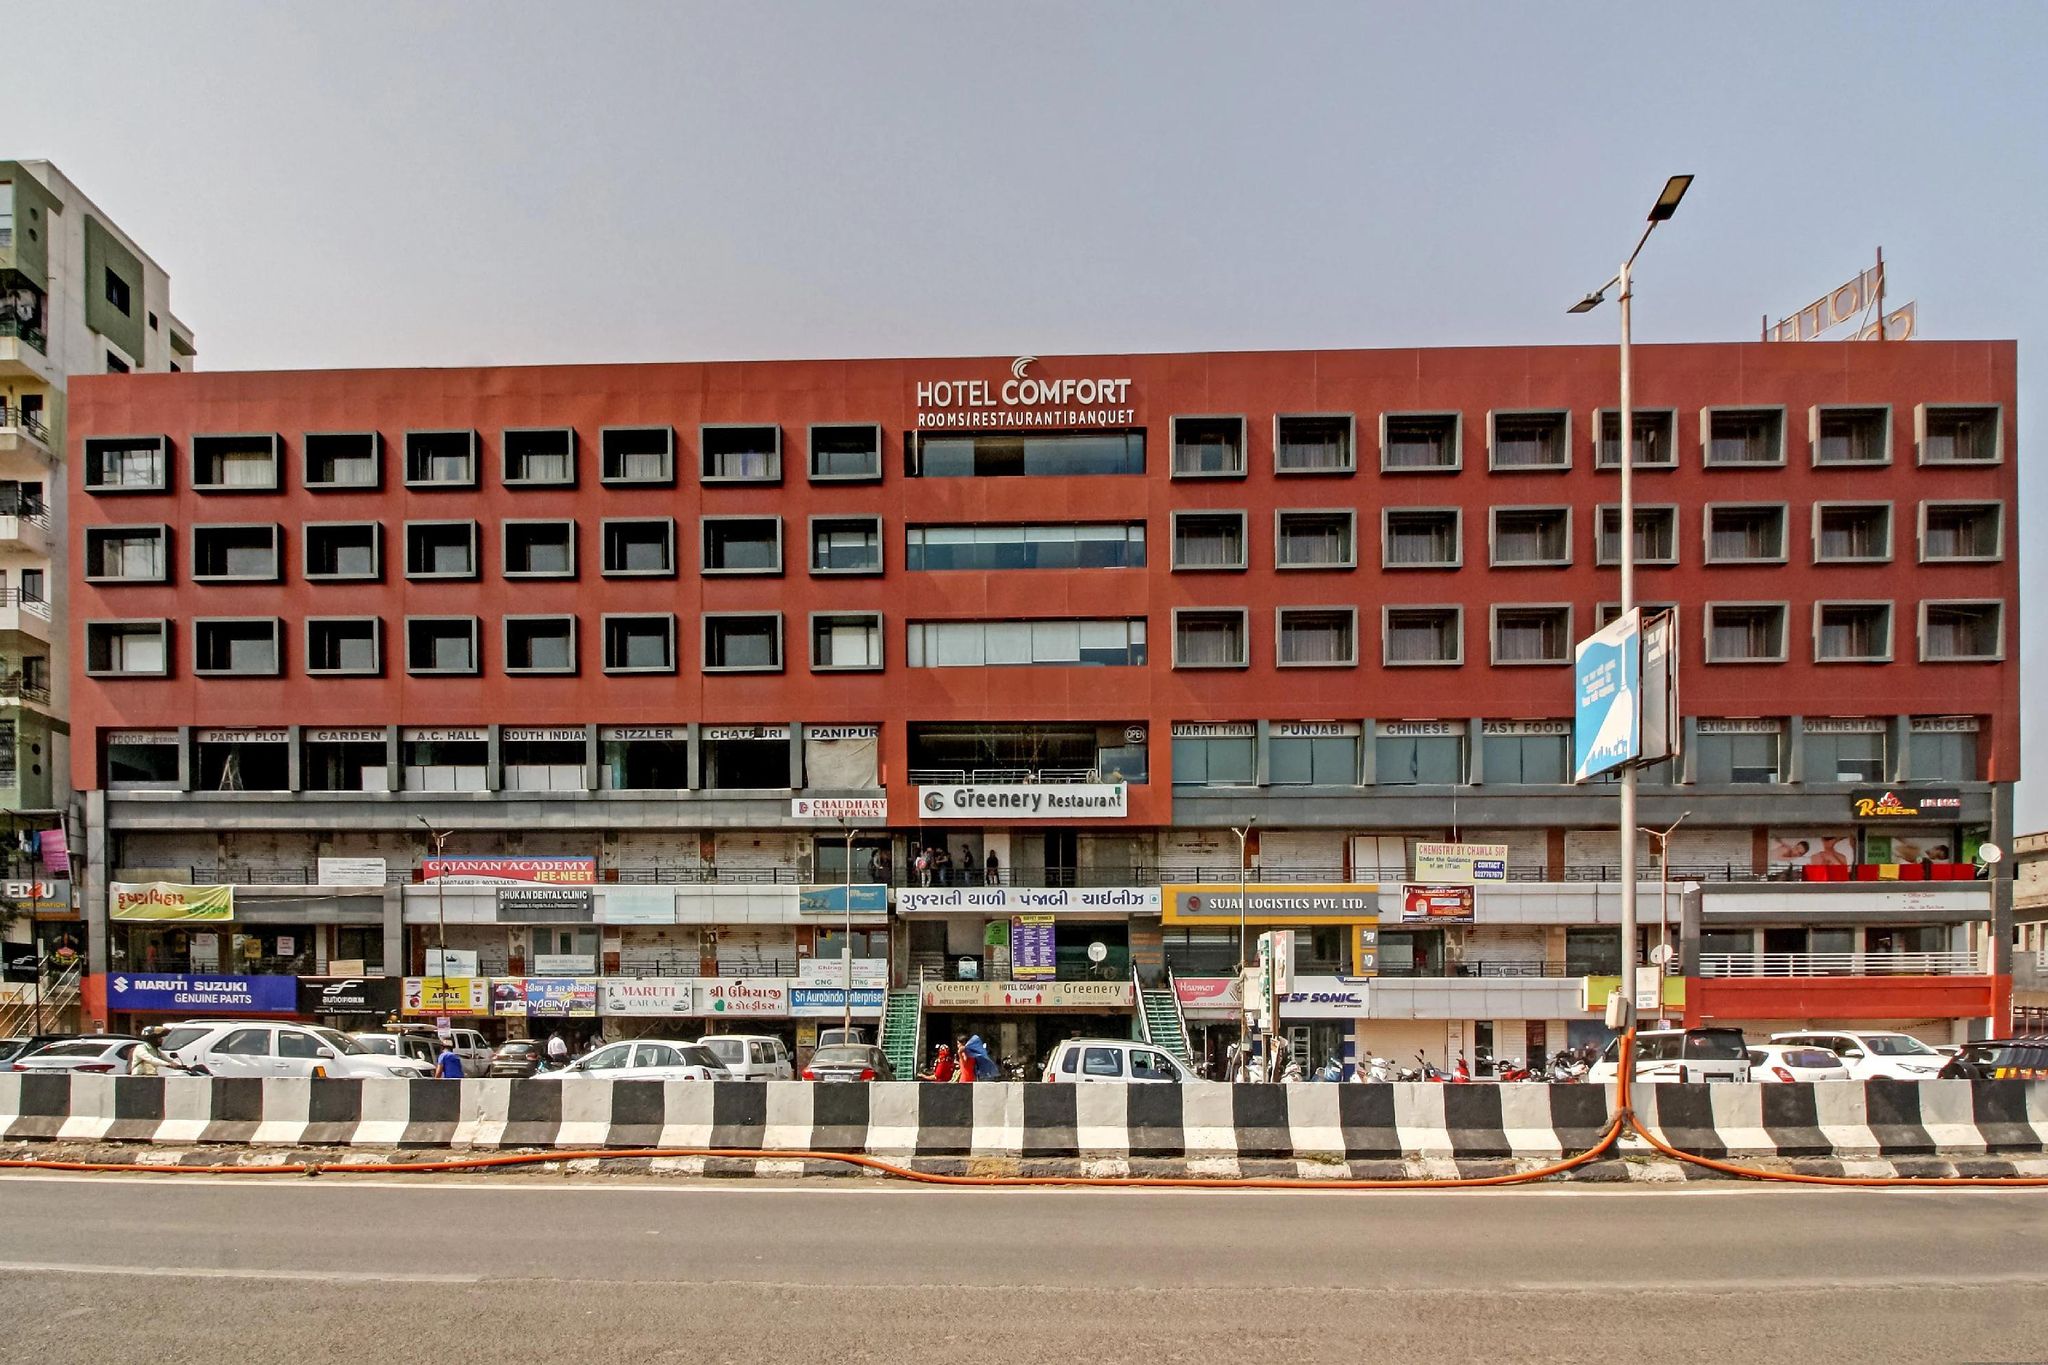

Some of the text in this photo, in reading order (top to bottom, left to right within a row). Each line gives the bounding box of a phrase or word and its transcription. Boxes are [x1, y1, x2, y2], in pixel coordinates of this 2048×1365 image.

[917, 378, 1131, 407] HOTEL COMFORT
[1280, 725, 1344, 735] PUNJABI
[1386, 725, 1449, 734] CHINESE
[1481, 723, 1564, 734] FAST FOOD
[1746, 720, 1776, 732] FOOD
[1912, 720, 1976, 730] PARCEL
[210, 732, 286, 742] PARTY PLOT
[317, 731, 381, 741] GARDEN
[417, 731, 480, 741] A.C. HALL
[504, 731, 544, 740] SOUTH
[615, 729, 673, 739] SIZZLER
[813, 800, 885, 809] CHAUDHARY
[953, 790, 1042, 812] Greenery
[1048, 794, 1121, 808] Restaurant
[813, 809, 879, 817] ENTERPRISES
[1418, 845, 1454, 855] CHEMISTRY
[1457, 846, 1465, 855] BY
[429, 861, 589, 870] GAJANAN ACADEMY
[500, 891, 588, 900] SHUKAN DENTAL CLINIC
[1248, 898, 1310, 909] LOGISTICS
[1313, 898, 1339, 909] PVT.
[1342, 899, 1367, 909] LTD.
[135, 980, 247, 991] MARUTI SUZUKI
[936, 983, 980, 992] Greenery
[1064, 983, 1120, 996] Greenery
[622, 986, 675, 996] MARUTI
[175, 993, 252, 1004] GENUINE PARTS
[795, 991, 805, 1002] Sri
[806, 991, 844, 1002] Aurobindo
[1310, 993, 1362, 1003] SONIC
